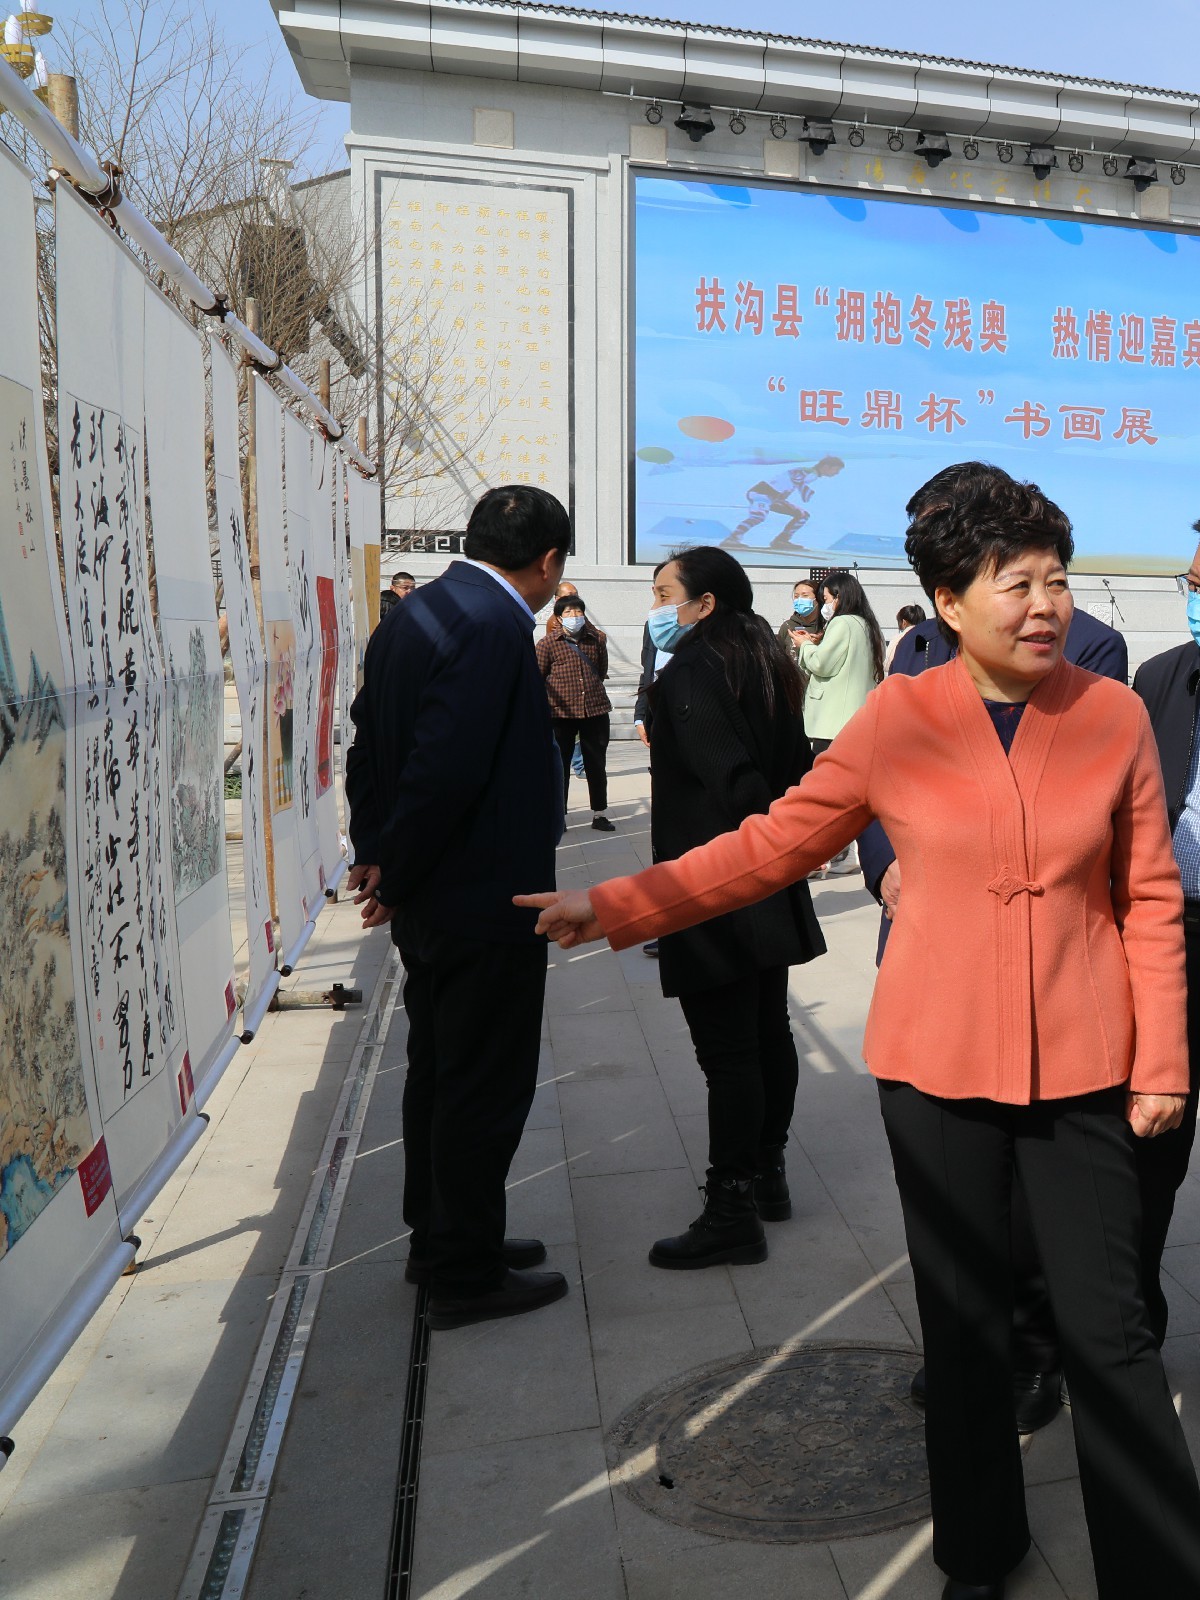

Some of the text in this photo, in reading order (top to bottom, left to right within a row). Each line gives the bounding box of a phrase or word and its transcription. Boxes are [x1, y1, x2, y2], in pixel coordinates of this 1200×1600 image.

[694, 276, 1009, 355] 扶沟县“拥抱冬残奥
[766, 376, 1159, 446] “旺鼎杯”书画展
